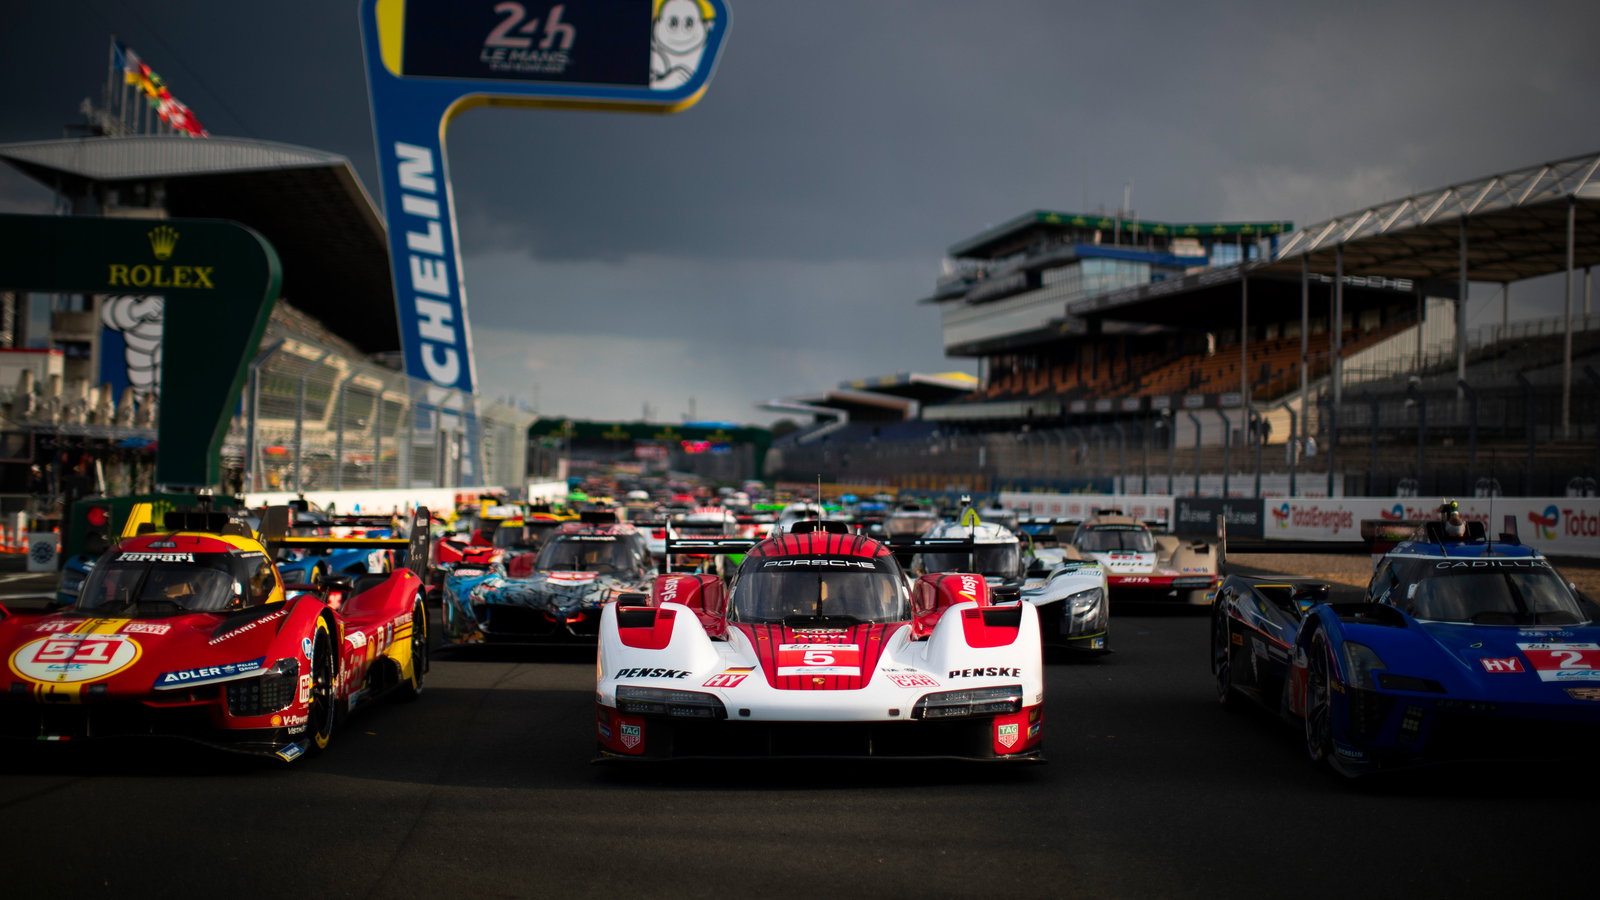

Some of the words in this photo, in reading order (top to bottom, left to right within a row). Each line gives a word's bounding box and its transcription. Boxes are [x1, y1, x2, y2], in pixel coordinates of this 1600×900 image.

[480, 48, 507, 63] LE
[107, 264, 215, 289] ROLEX
[1291, 505, 1353, 534] TotalEnergies
[115, 552, 196, 563] Ferrari
[763, 559, 876, 569] PORSCHE
[958, 576, 979, 602] Ansys
[36, 623, 73, 632] HY
[208, 622, 257, 646] RICHARD
[256, 609, 289, 625] MILLE
[37, 641, 110, 661] 51
[803, 650, 835, 666] 5
[1550, 650, 1592, 669] 2
[1483, 659, 1516, 671] HY
[164, 667, 221, 682] ADLER
[614, 667, 693, 680] PENSKE
[948, 667, 1022, 679] PENSKE
[704, 674, 747, 687] HY
[897, 679, 936, 687] CAR
[621, 726, 639, 735] TAG
[1000, 726, 1017, 735] TAG
